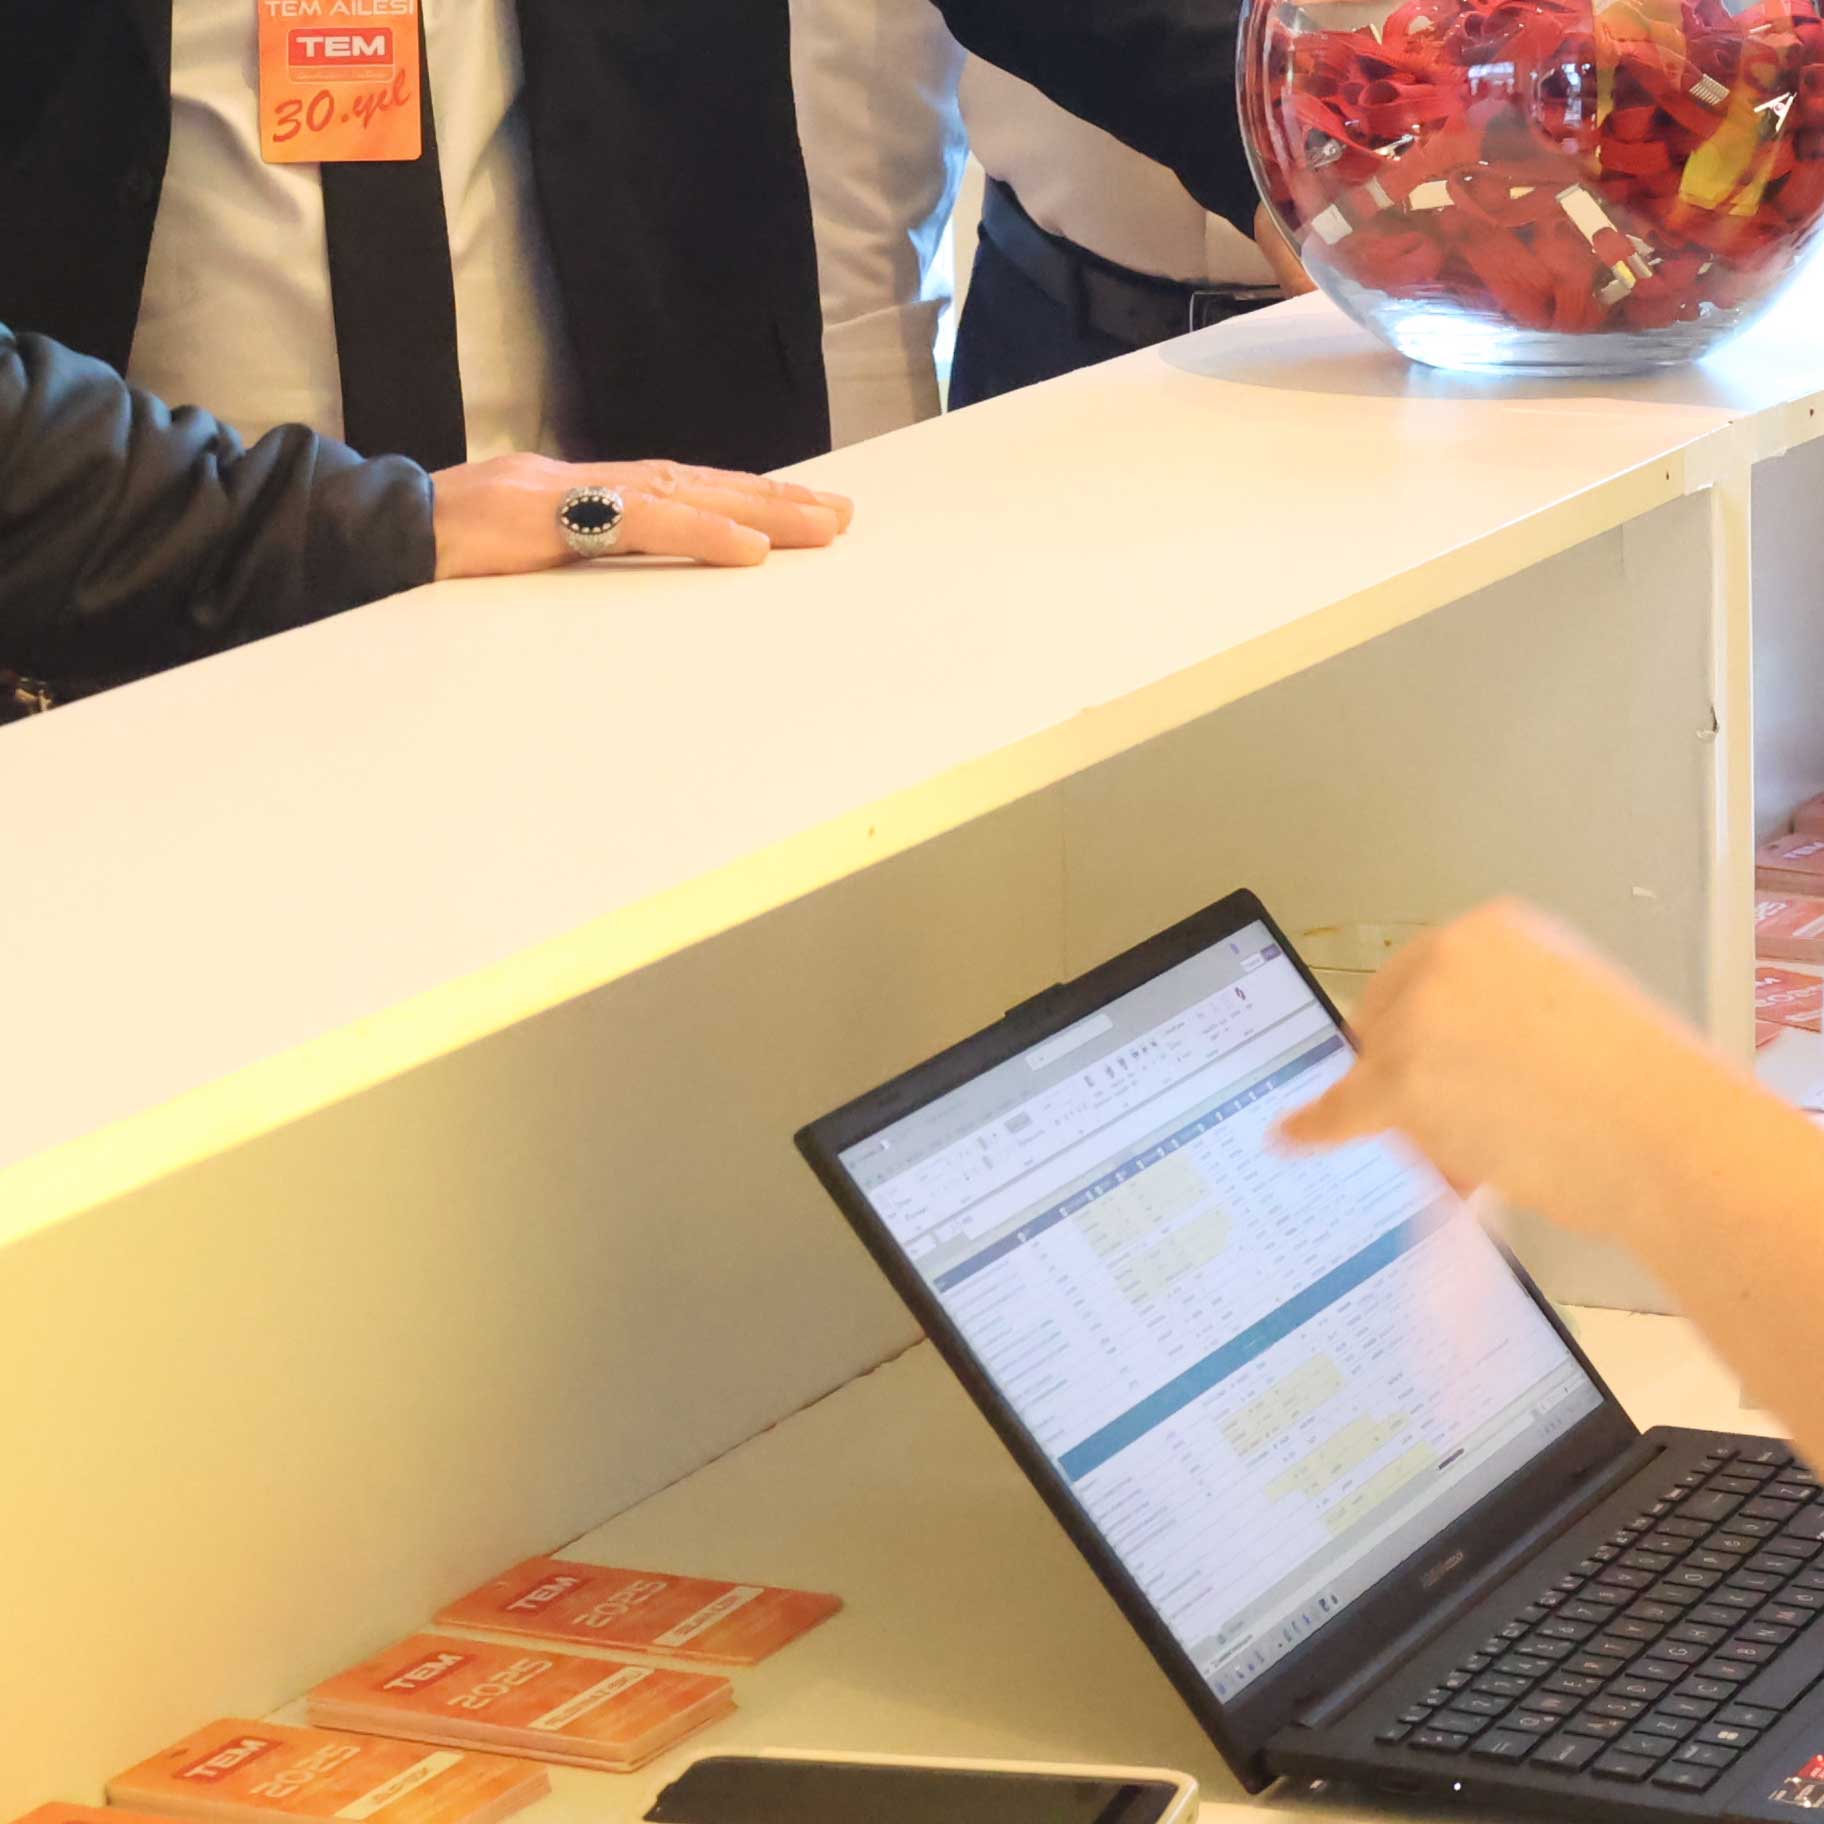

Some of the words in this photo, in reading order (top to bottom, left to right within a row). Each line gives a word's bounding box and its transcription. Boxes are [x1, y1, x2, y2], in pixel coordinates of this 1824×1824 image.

[265, 0, 322, 17] TEM
[296, 35, 386, 57] TEM
[505, 1575, 581, 1612] TEM
[572, 1578, 668, 1629] 2025
[383, 1652, 465, 1692] TEM
[448, 1657, 554, 1711] 2025
[183, 1739, 268, 1778] TEM
[249, 1744, 361, 1799] 2025
